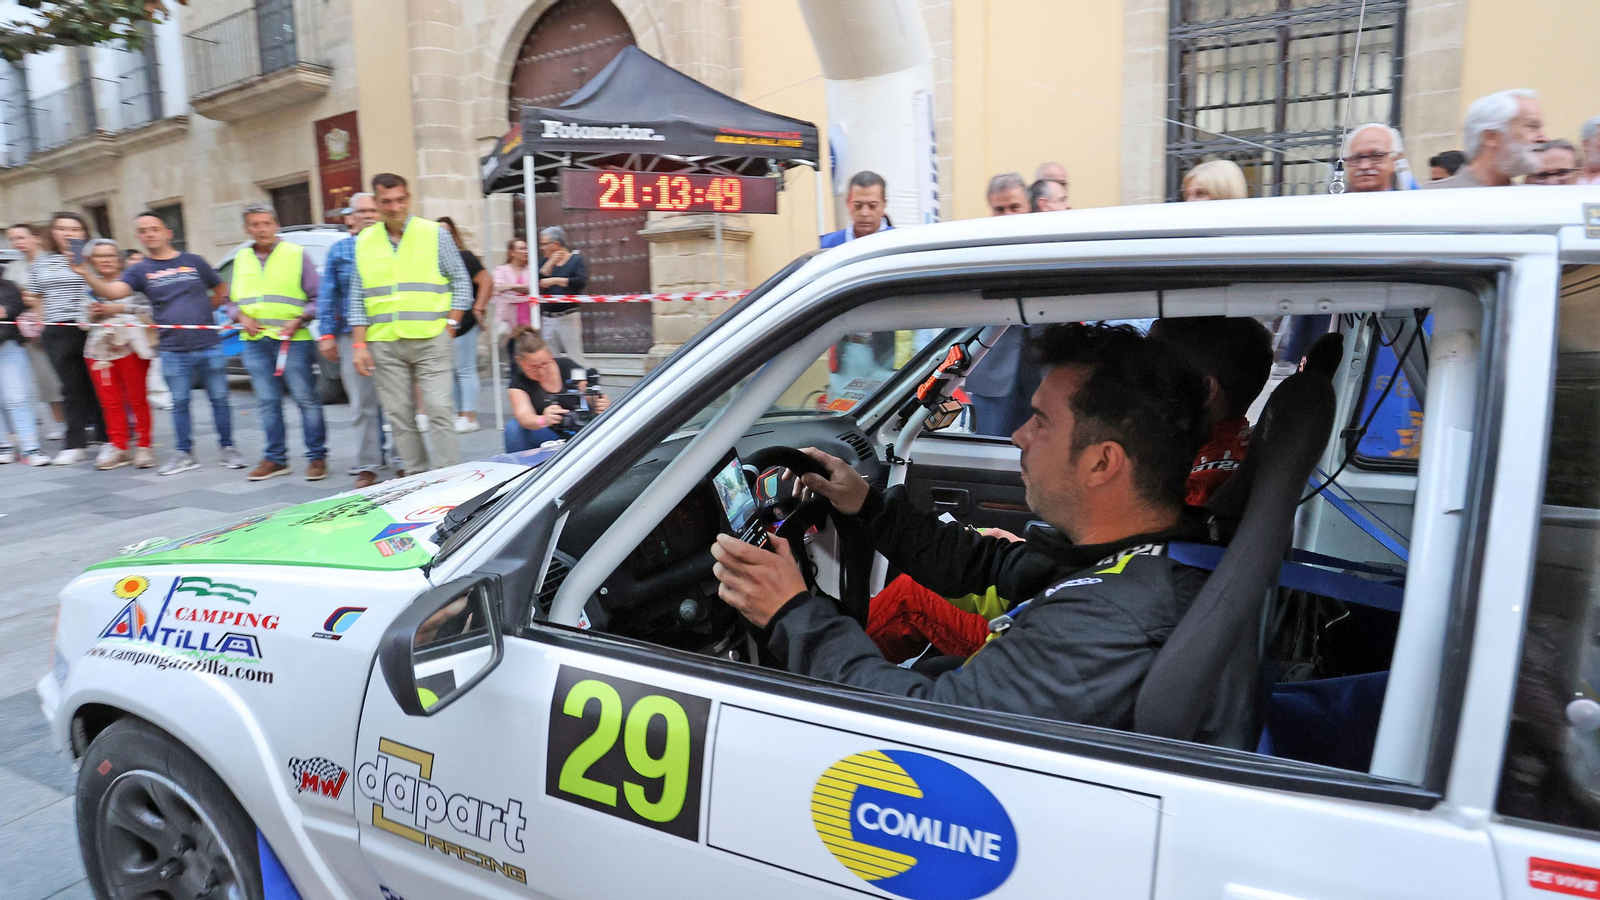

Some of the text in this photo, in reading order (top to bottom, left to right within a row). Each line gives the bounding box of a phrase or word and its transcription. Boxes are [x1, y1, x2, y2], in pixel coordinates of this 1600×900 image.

[598, 173, 742, 211] 21:13:49
[175, 606, 281, 630] CAMPING
[558, 679, 691, 823] 29
[301, 769, 349, 800] MW
[357, 754, 527, 853] dapart
[856, 802, 1002, 862] COMLINE
[428, 834, 528, 885] RACING
